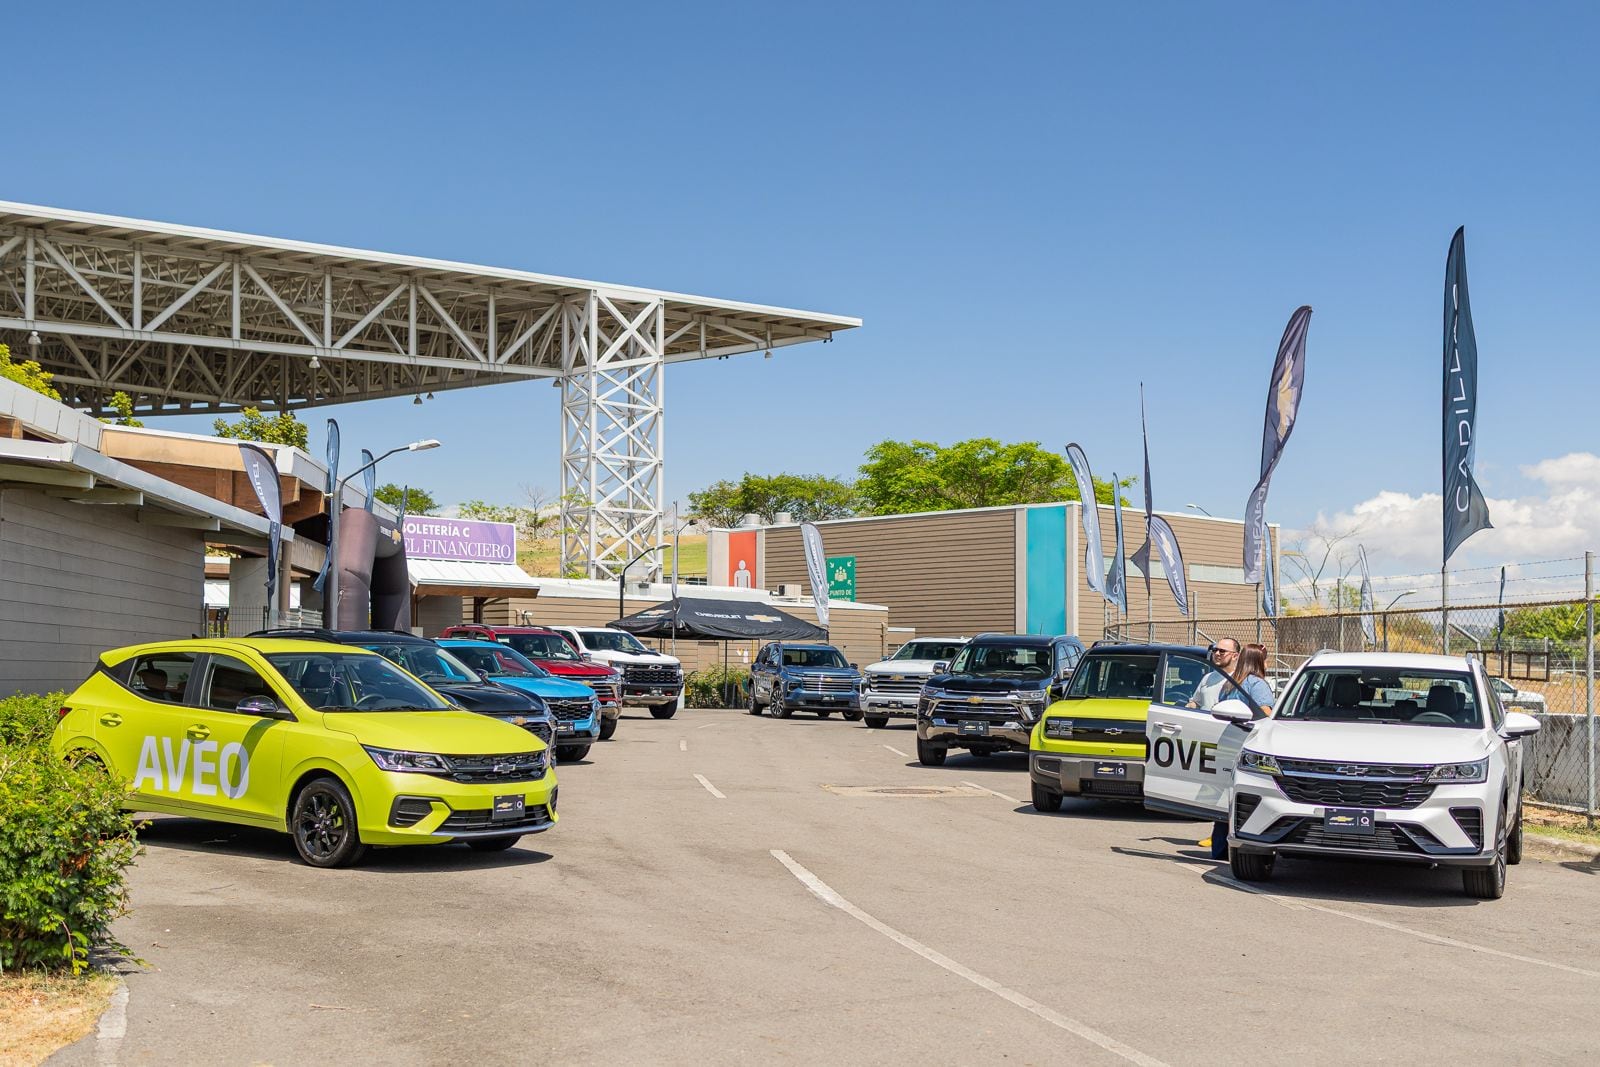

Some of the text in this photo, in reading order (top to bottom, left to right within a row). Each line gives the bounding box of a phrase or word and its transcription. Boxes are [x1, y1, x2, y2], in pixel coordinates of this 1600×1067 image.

[463, 527, 470, 538] C
[423, 539, 512, 559] FINANCIERO
[133, 735, 249, 799] AVEO
